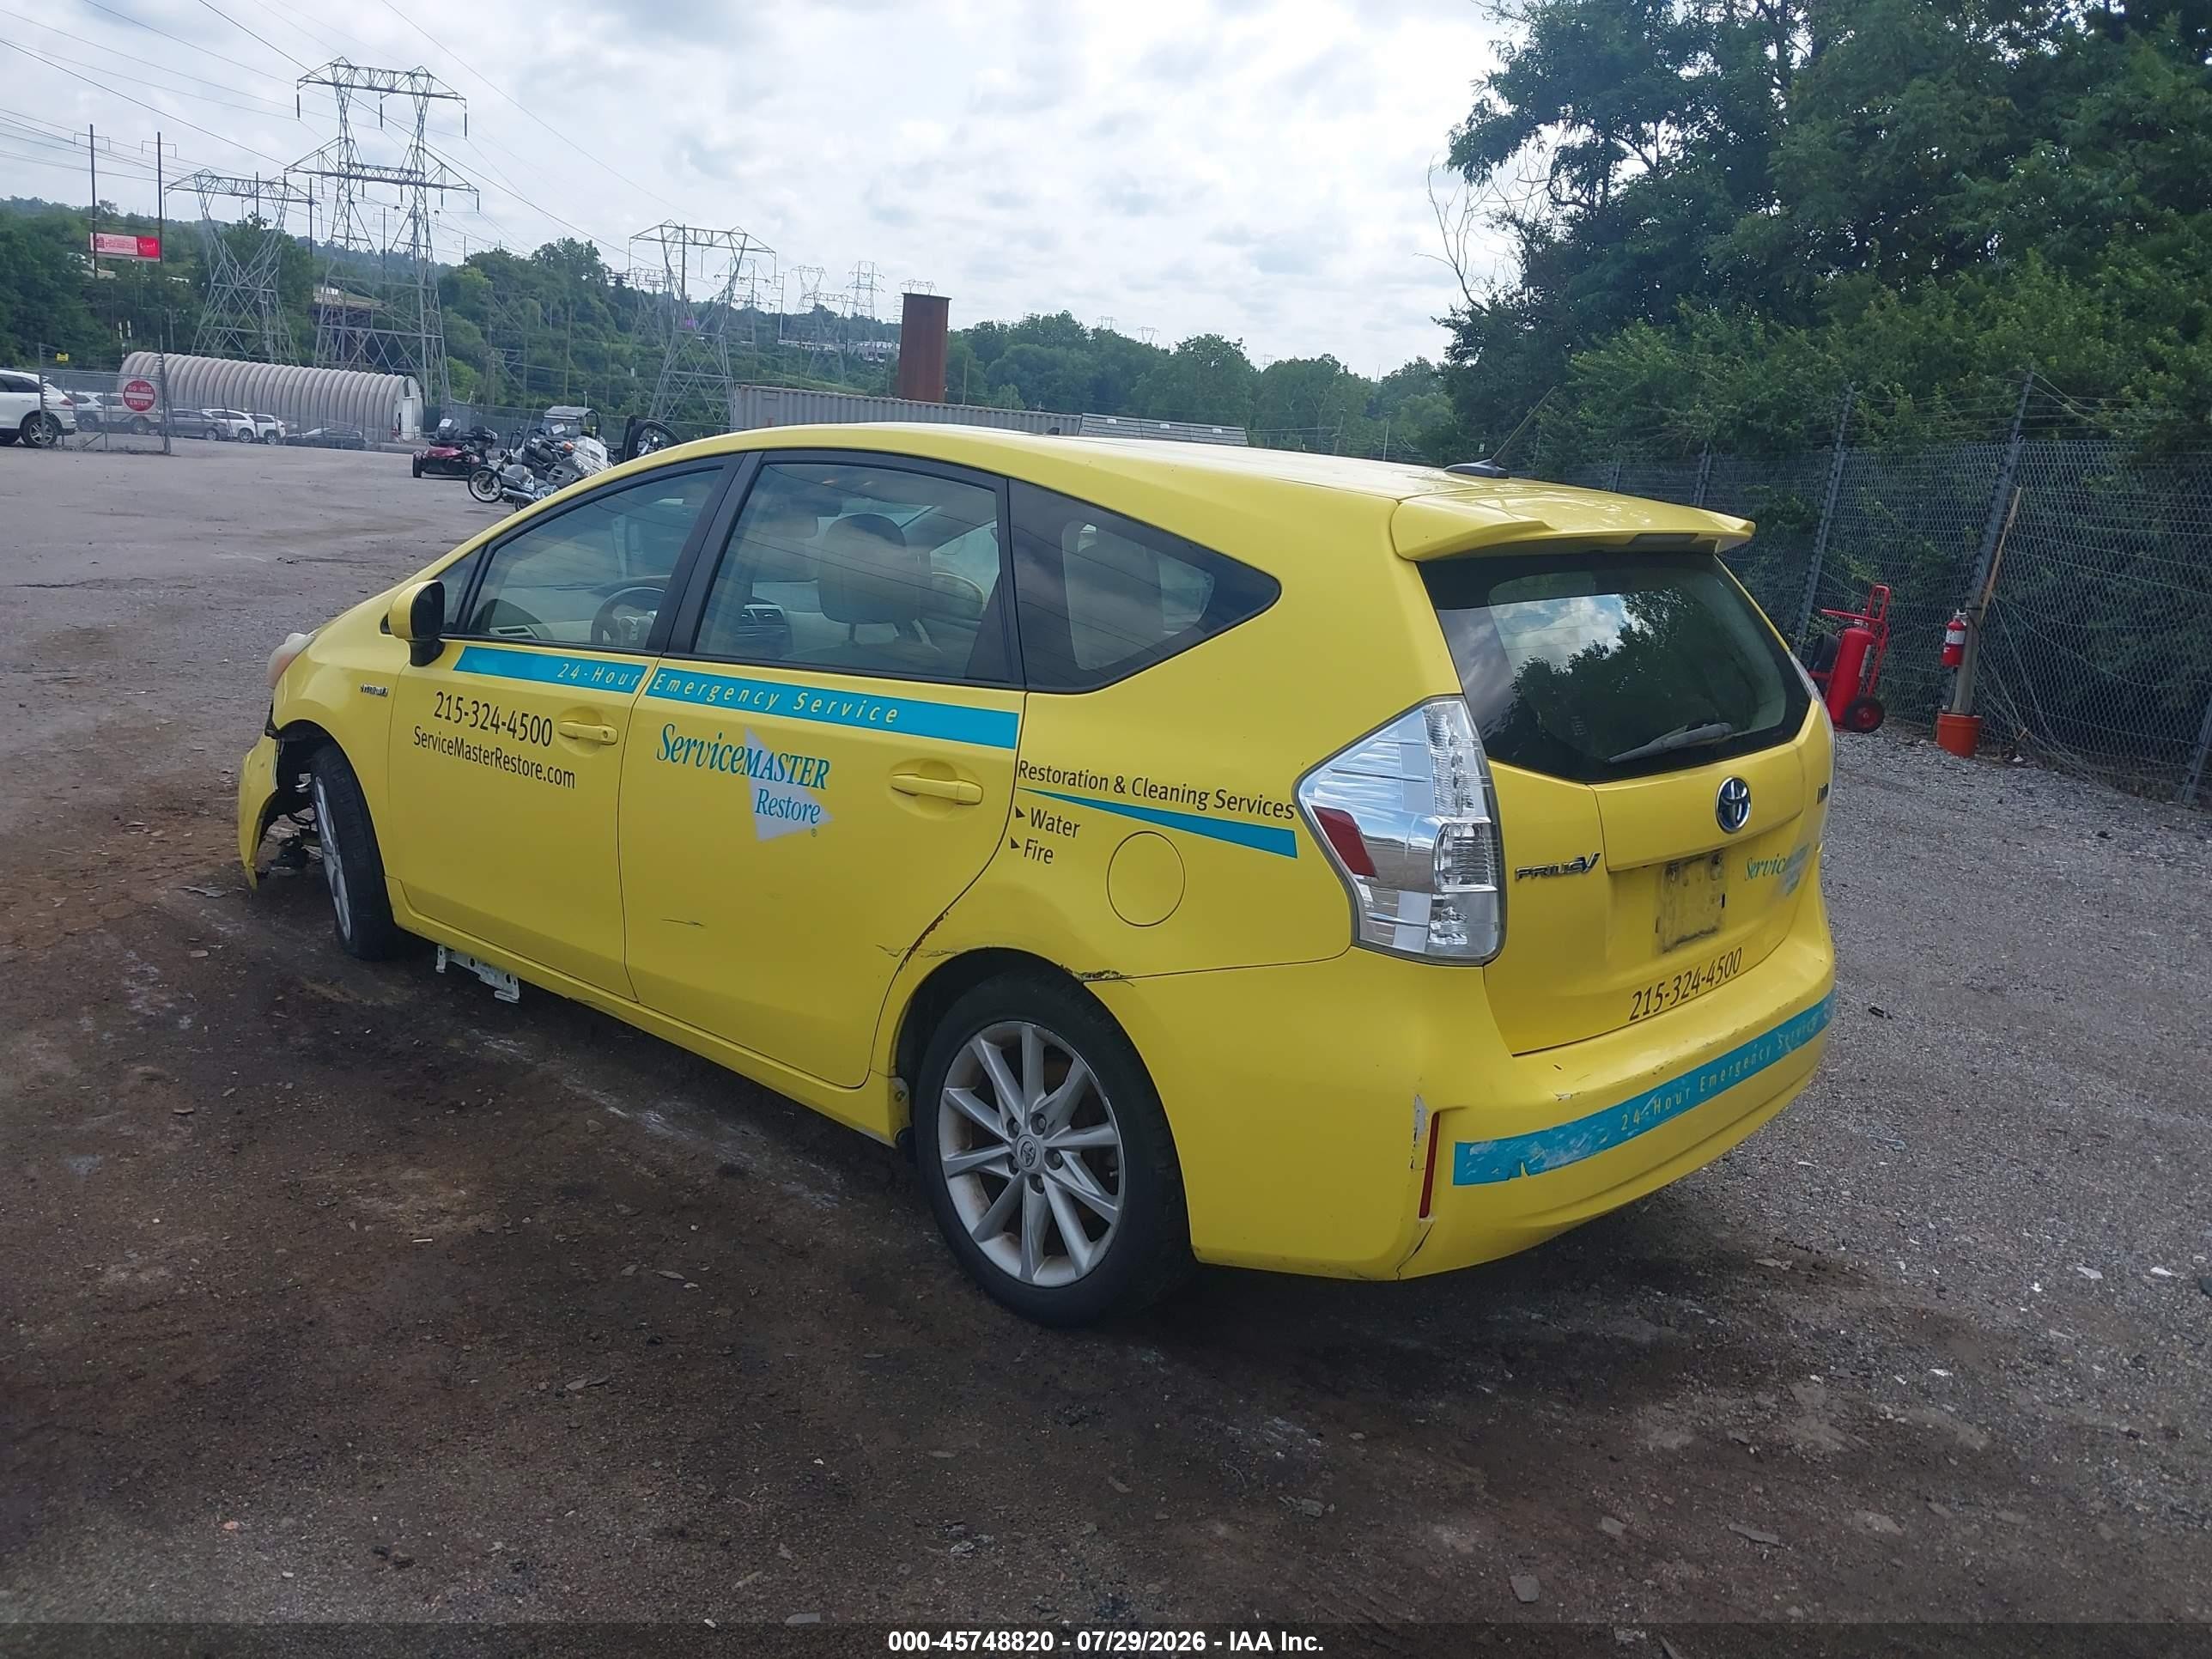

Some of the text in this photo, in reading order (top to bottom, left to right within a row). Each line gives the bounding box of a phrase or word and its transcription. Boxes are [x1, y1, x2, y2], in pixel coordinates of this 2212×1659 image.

[433, 690, 553, 748] 215-324-4500
[556, 662, 900, 724] 24-Hour Emergency Service
[413, 725, 576, 790] ServiceMasterRestore.com
[656, 722, 831, 791] ServiceMASTER
[754, 787, 821, 824] Restore
[1018, 759, 1296, 820] Restoration & Cleaning Services
[1023, 838, 1054, 865] Fire
[1030, 805, 1081, 839] Water
[1628, 945, 1743, 1022] 215-324-4500
[1620, 1087, 1691, 1132] 24-Hour
[1698, 1043, 1772, 1093] Emergency
